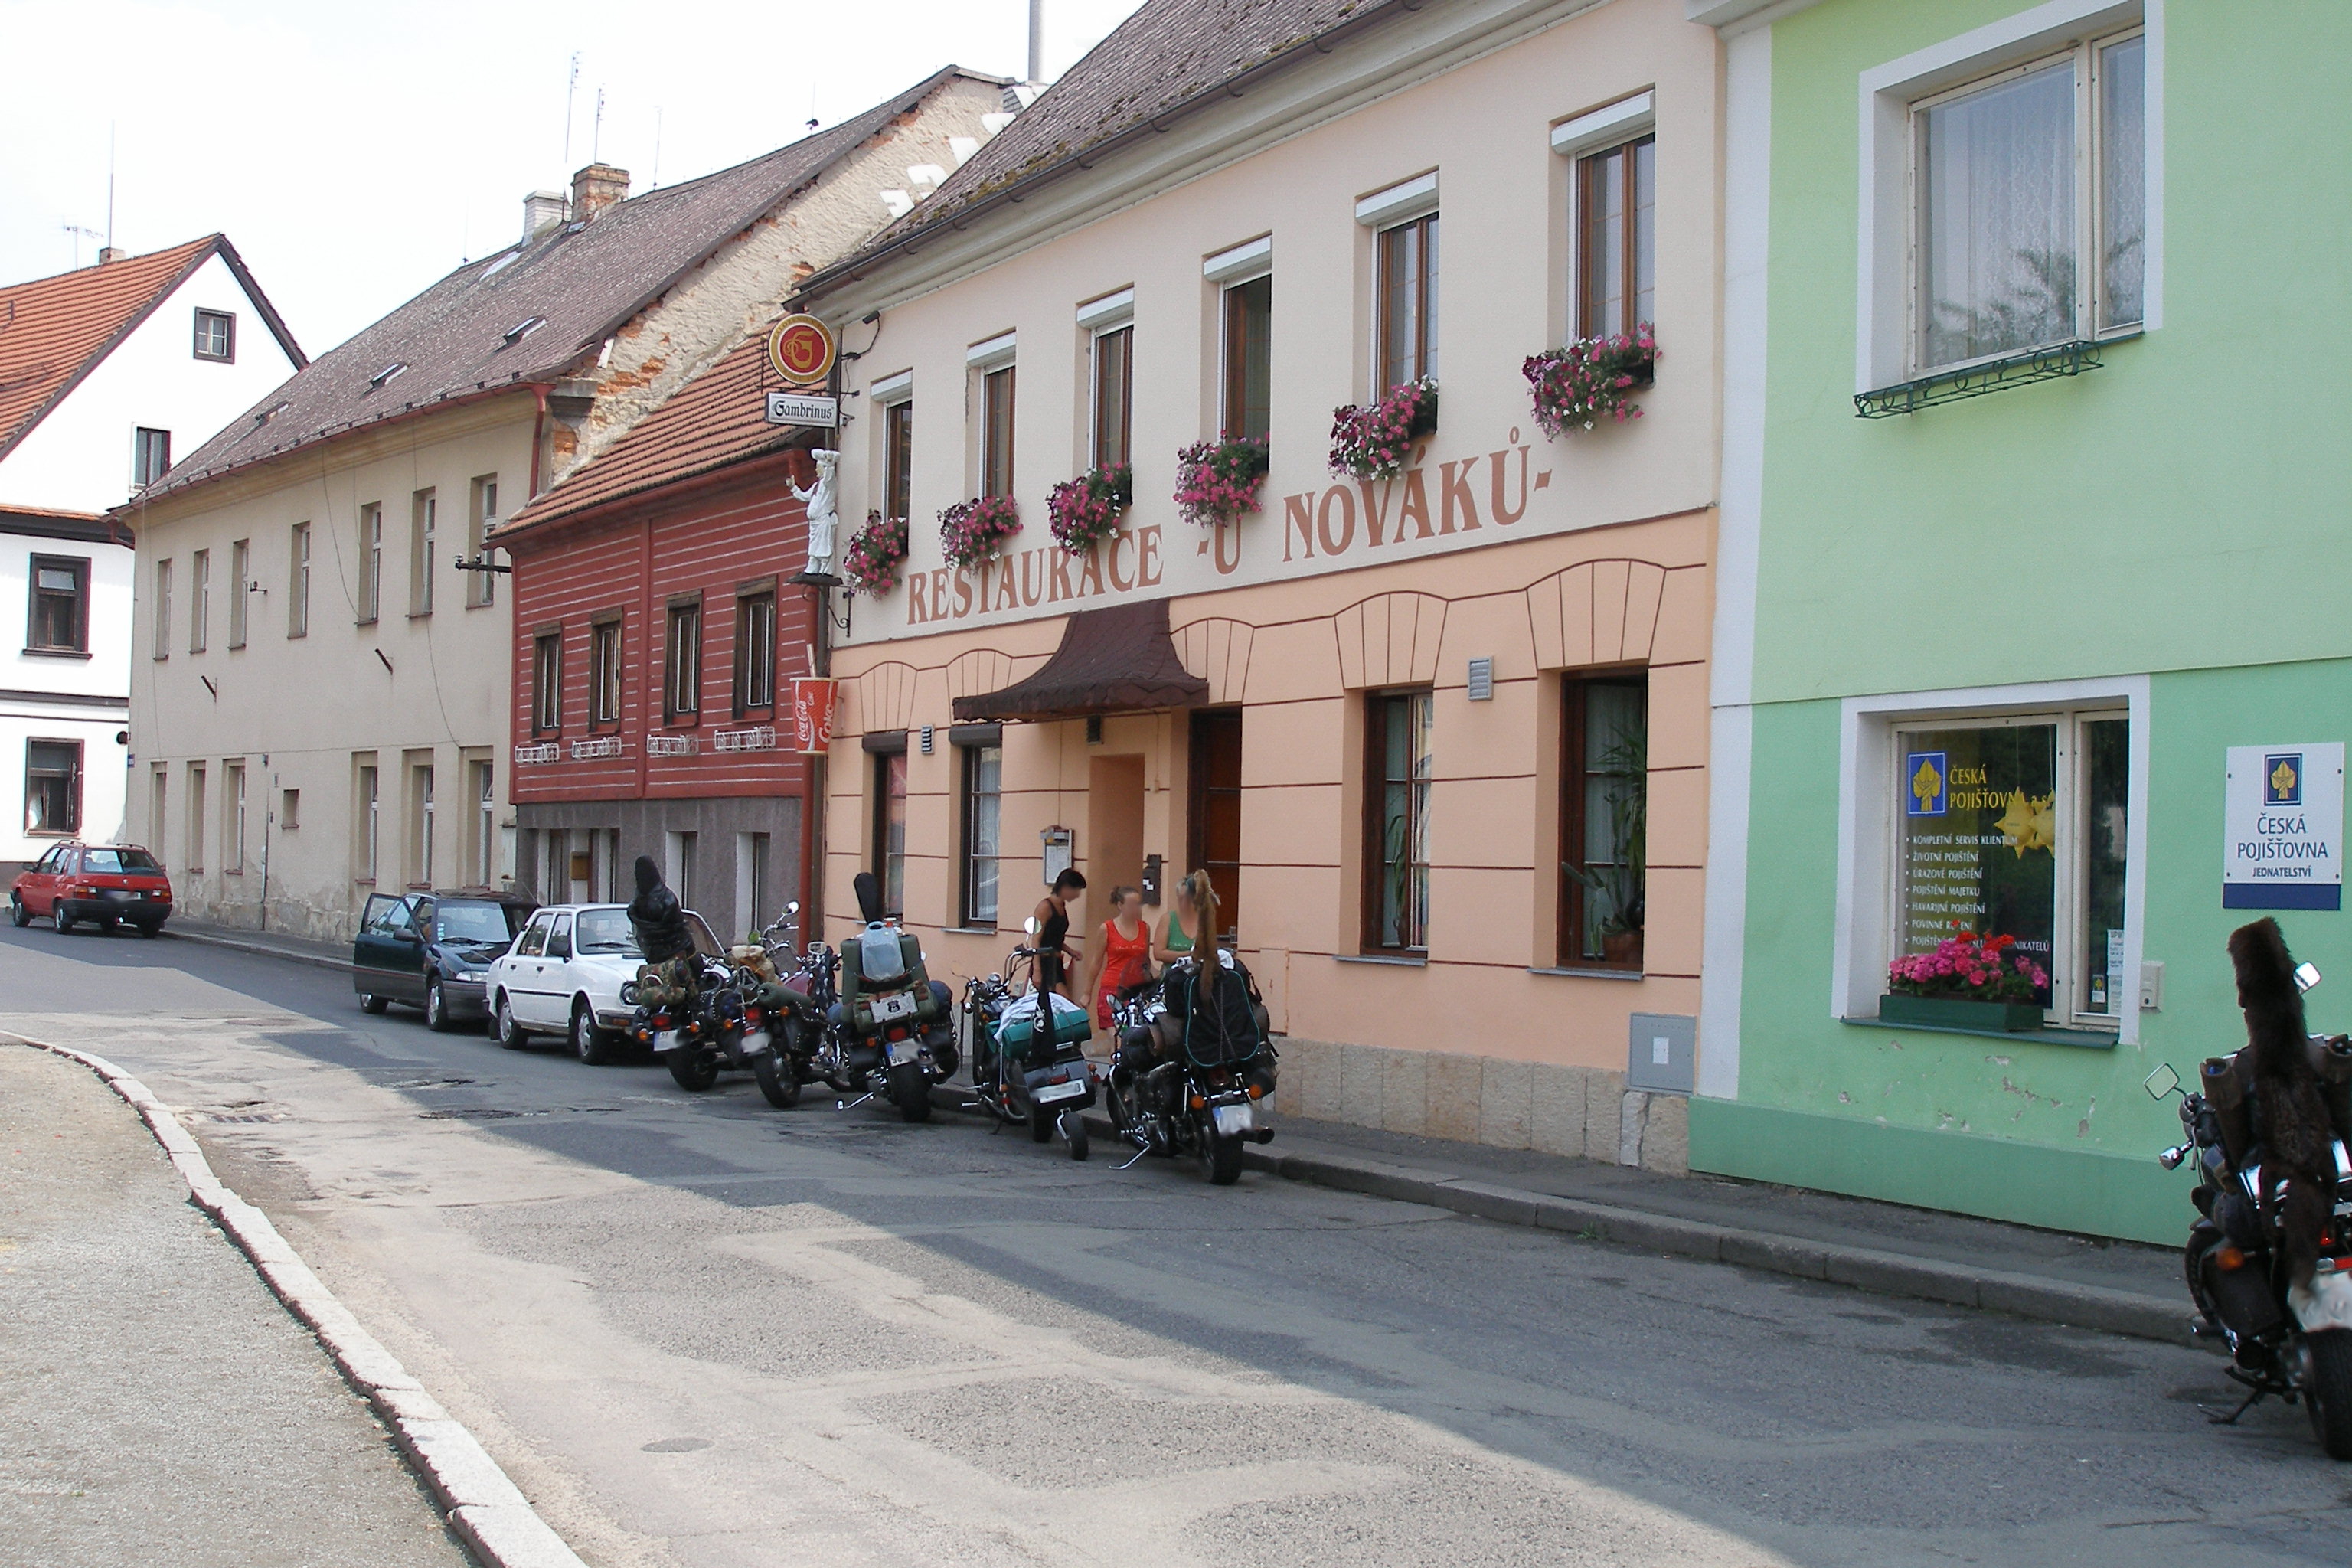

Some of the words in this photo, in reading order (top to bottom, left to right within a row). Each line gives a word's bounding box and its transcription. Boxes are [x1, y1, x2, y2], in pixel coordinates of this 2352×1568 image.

[773, 400, 832, 419] Gambrinus
[906, 524, 1165, 625] RESTAURACE
[818, 704, 834, 743] Coke
[1949, 763, 1986, 784] ČESKÁ
[2257, 812, 2306, 835] ČESKÁ
[1913, 833, 1952, 844] KOMPLETNÍ
[1955, 835, 1978, 844] SERVIS
[2237, 838, 2328, 861] POJIŠŤOVNA
[1913, 850, 1942, 861] ŽIVOTNÍ
[1945, 850, 1978, 863] POJIŠTĚNÍ
[1948, 867, 1983, 880] POJIŠTĚNÍ
[2252, 865, 2311, 877] JEDNATELSTVÍ
[1913, 884, 1946, 896] POJIŠTĚNÍ
[1948, 886, 1980, 897] MAJETKU
[1912, 900, 1948, 913] HAVARIJNÍ
[1951, 902, 1985, 914] POJIŠTĚNÍ
[1912, 918, 1943, 929] POVINNÉ
[1946, 919, 1972, 930] RENÍ
[1912, 934, 1945, 946] POJIŠTĚ
